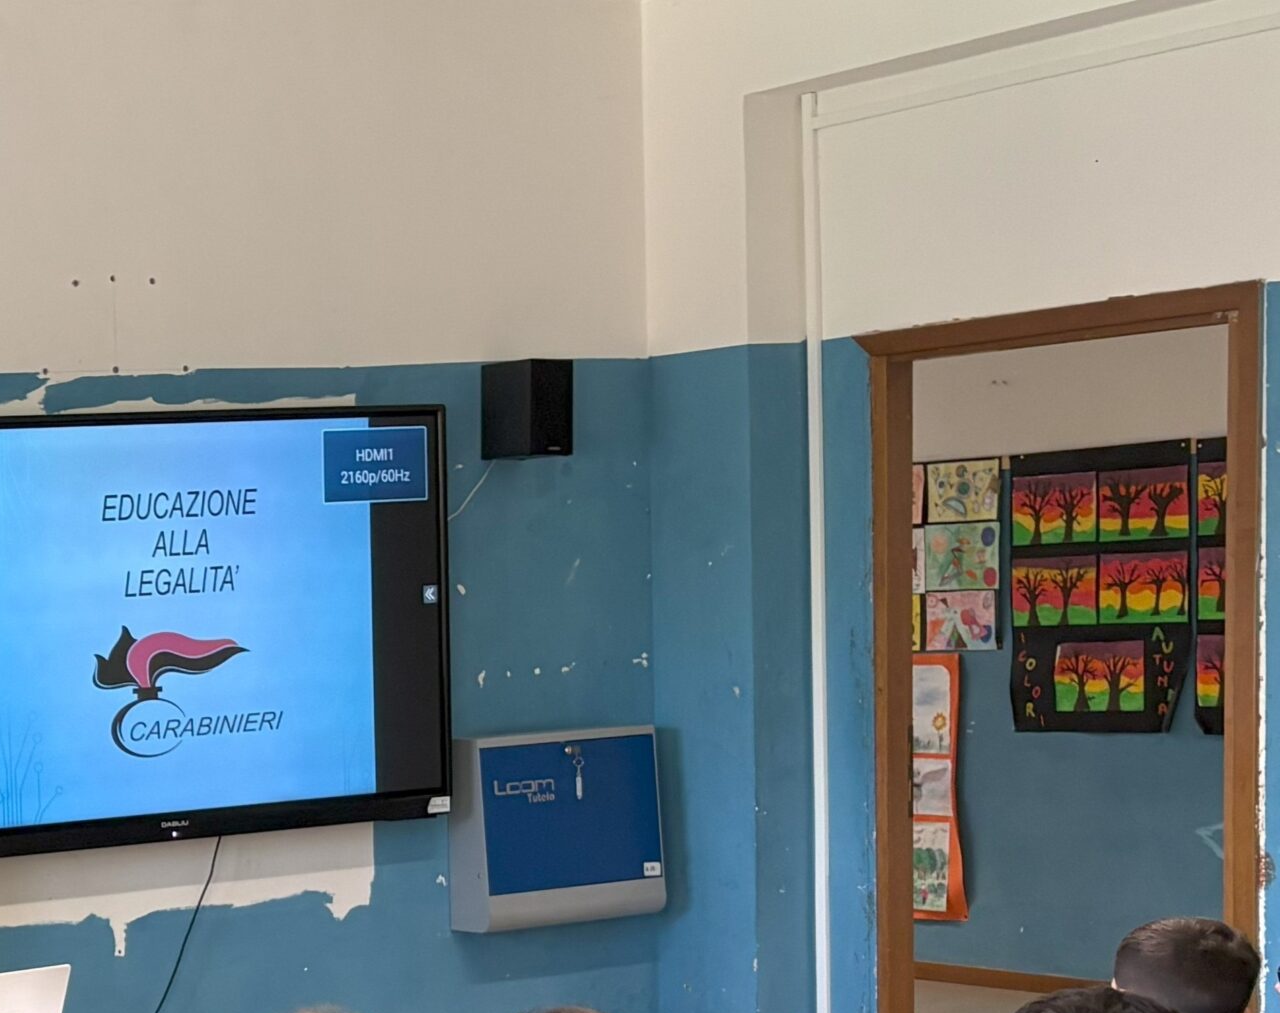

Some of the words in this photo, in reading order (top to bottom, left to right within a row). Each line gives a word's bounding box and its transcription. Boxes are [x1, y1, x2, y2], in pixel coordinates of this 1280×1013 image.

[356, 448, 393, 462] HDMI1
[341, 469, 411, 486] 2160p/60Hz
[102, 488, 257, 521] EDUCAZIONE
[152, 529, 210, 557] ALLA
[125, 565, 239, 597] LEGALITA'
[130, 711, 283, 741] CARABINIERI
